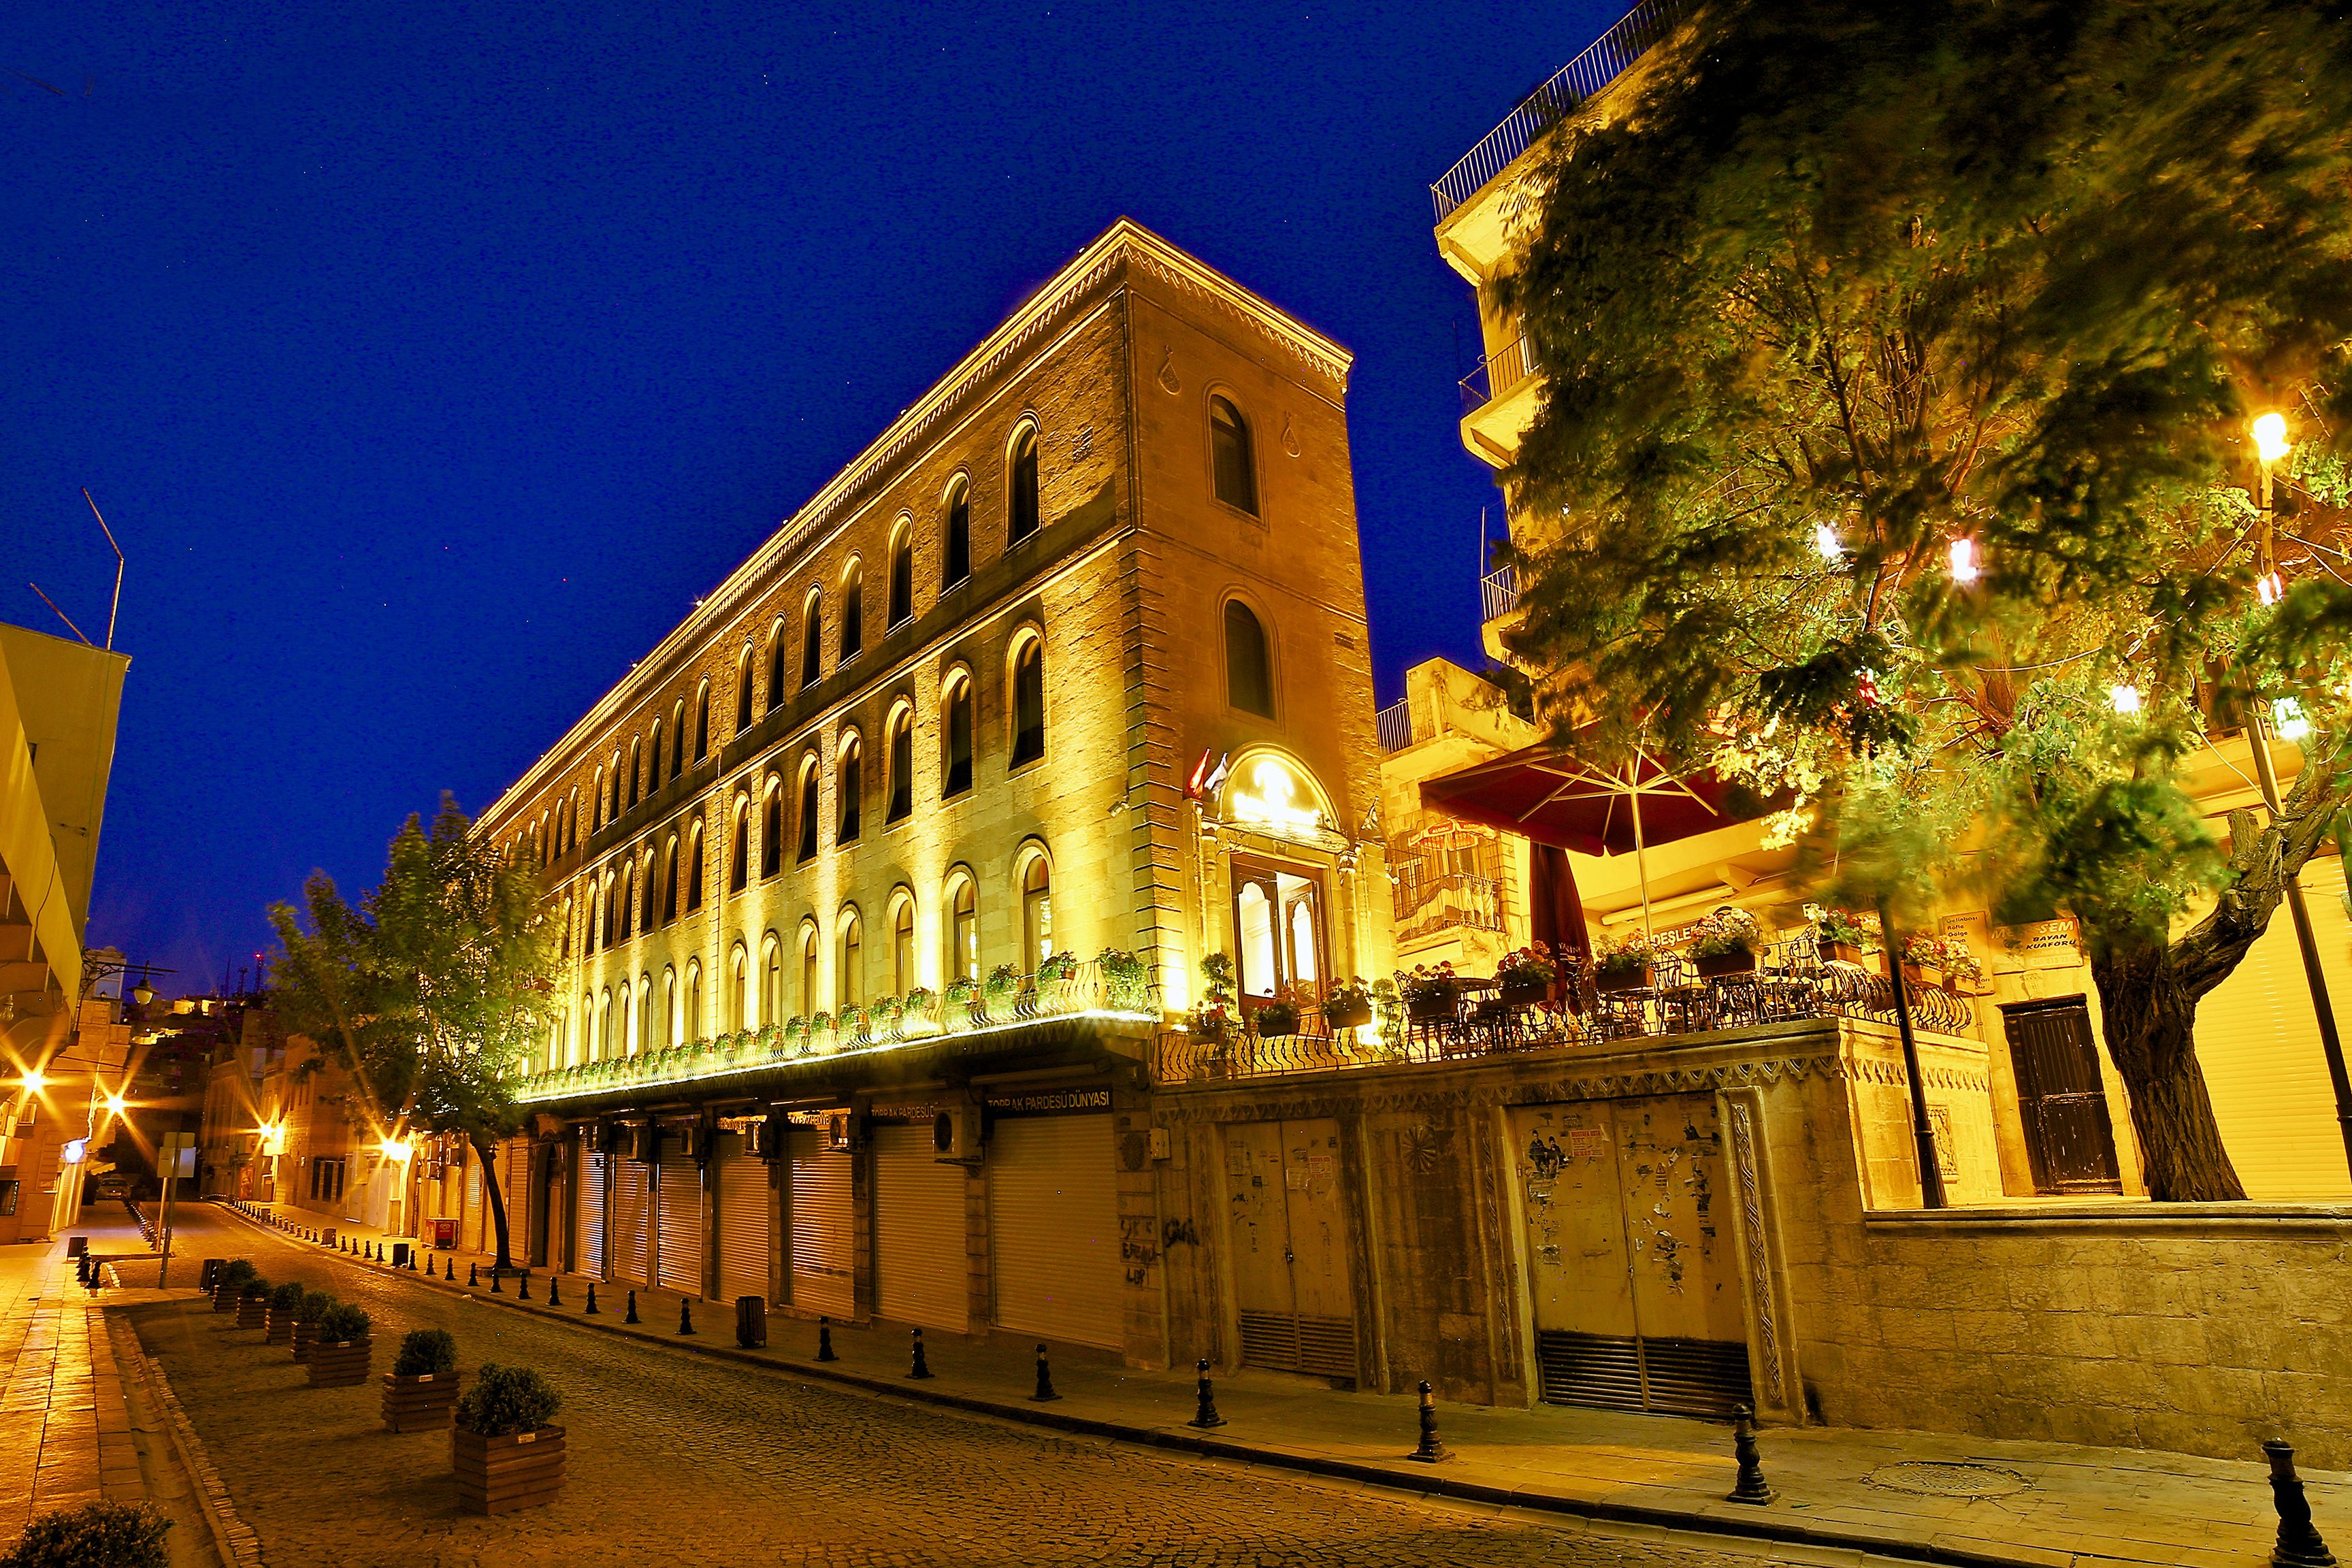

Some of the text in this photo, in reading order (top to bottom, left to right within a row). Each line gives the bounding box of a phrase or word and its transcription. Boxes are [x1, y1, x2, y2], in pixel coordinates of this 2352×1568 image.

[2039, 921, 2074, 934] SEM
[2032, 934, 2068, 942] BAYAN
[1026, 1090, 1068, 1111] PARDESÜ
[1069, 1090, 1109, 1108] DÜNYASI
